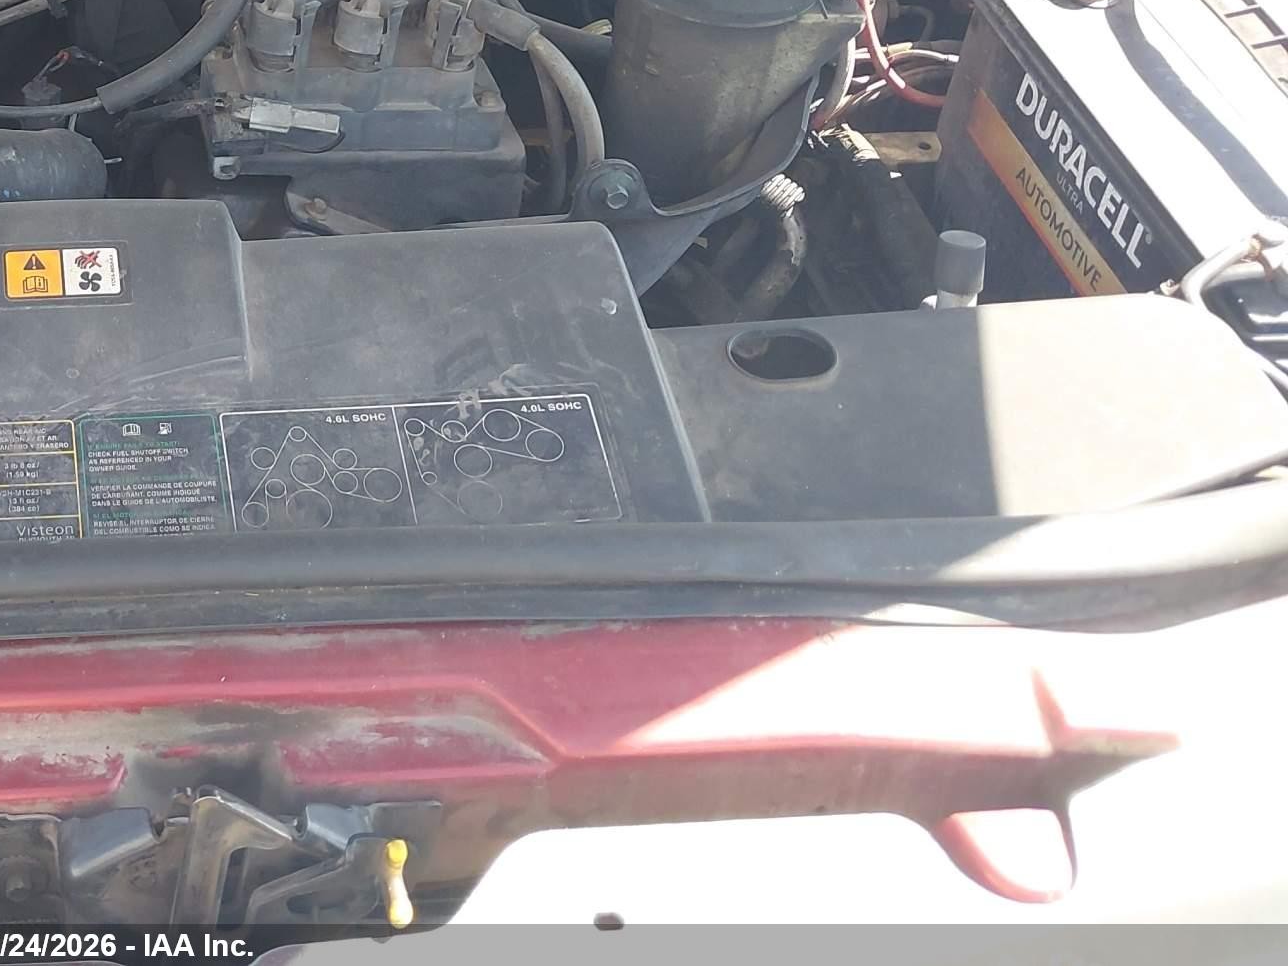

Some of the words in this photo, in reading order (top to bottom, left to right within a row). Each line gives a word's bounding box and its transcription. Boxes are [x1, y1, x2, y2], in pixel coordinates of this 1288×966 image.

[1015, 72, 1142, 269] DURACELL
[1055, 174, 1086, 215] ULTRA
[1014, 166, 1103, 293] AUTOMOTIVE
[520, 403, 545, 414] 4.0L
[548, 400, 582, 412] SOHC
[325, 414, 350, 424] 4.6L
[352, 412, 386, 423] SOHC
[184, 480, 216, 488] COUPURE
[16, 525, 74, 536] Visteon
